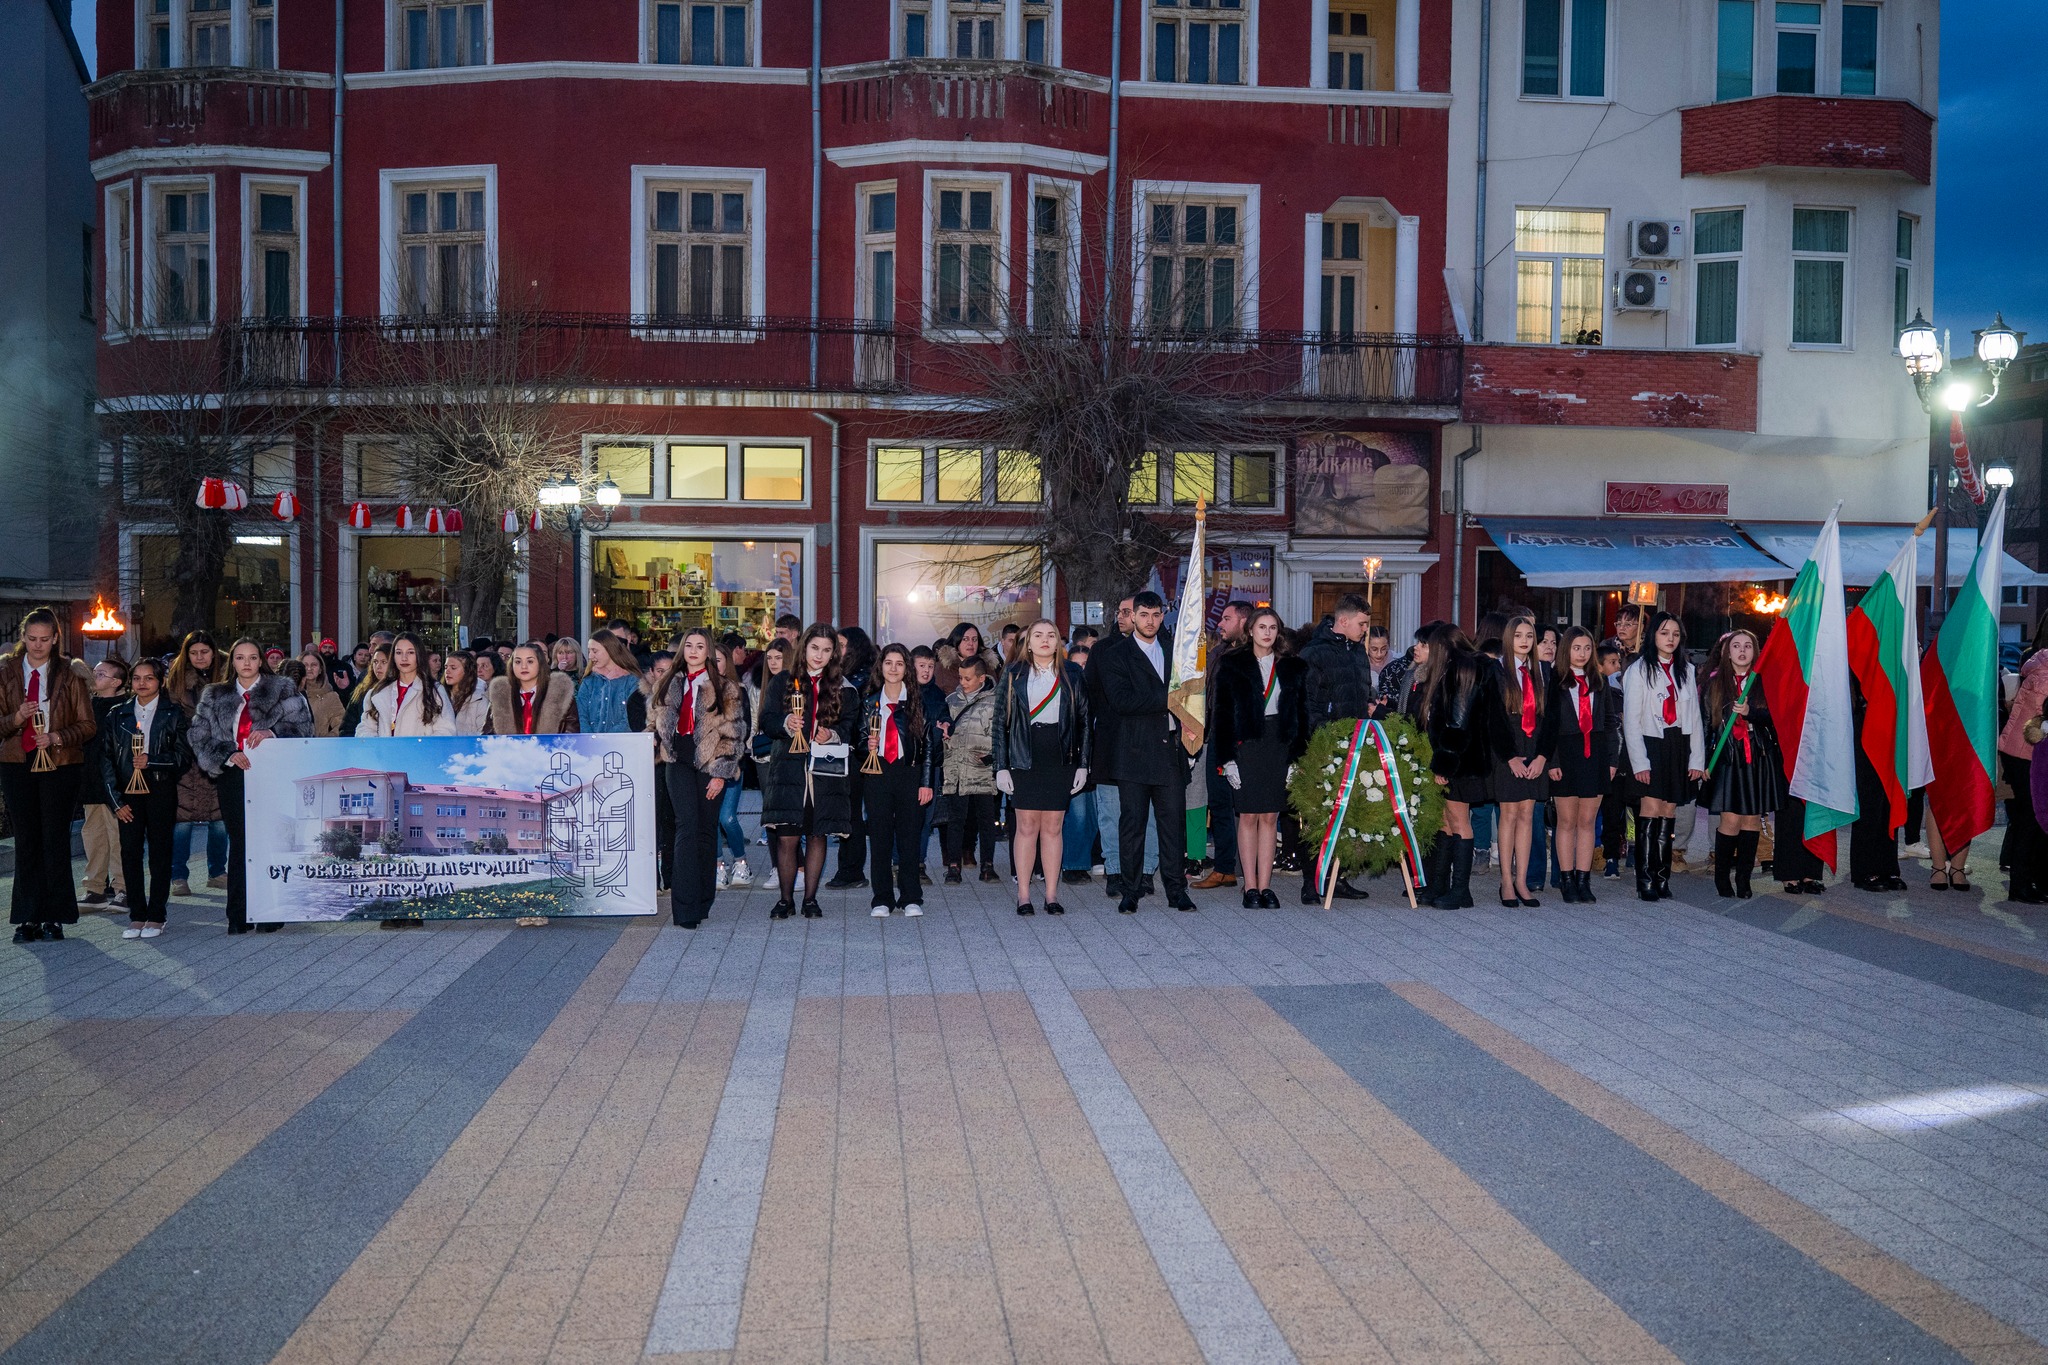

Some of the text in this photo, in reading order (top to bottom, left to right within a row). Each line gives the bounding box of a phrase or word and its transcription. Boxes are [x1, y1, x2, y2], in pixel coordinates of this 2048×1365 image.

[267, 864, 292, 883] СУ
[360, 861, 420, 877] КИРИЛ
[420, 861, 437, 876] И
[376, 881, 456, 898] ЯКОРУДА
